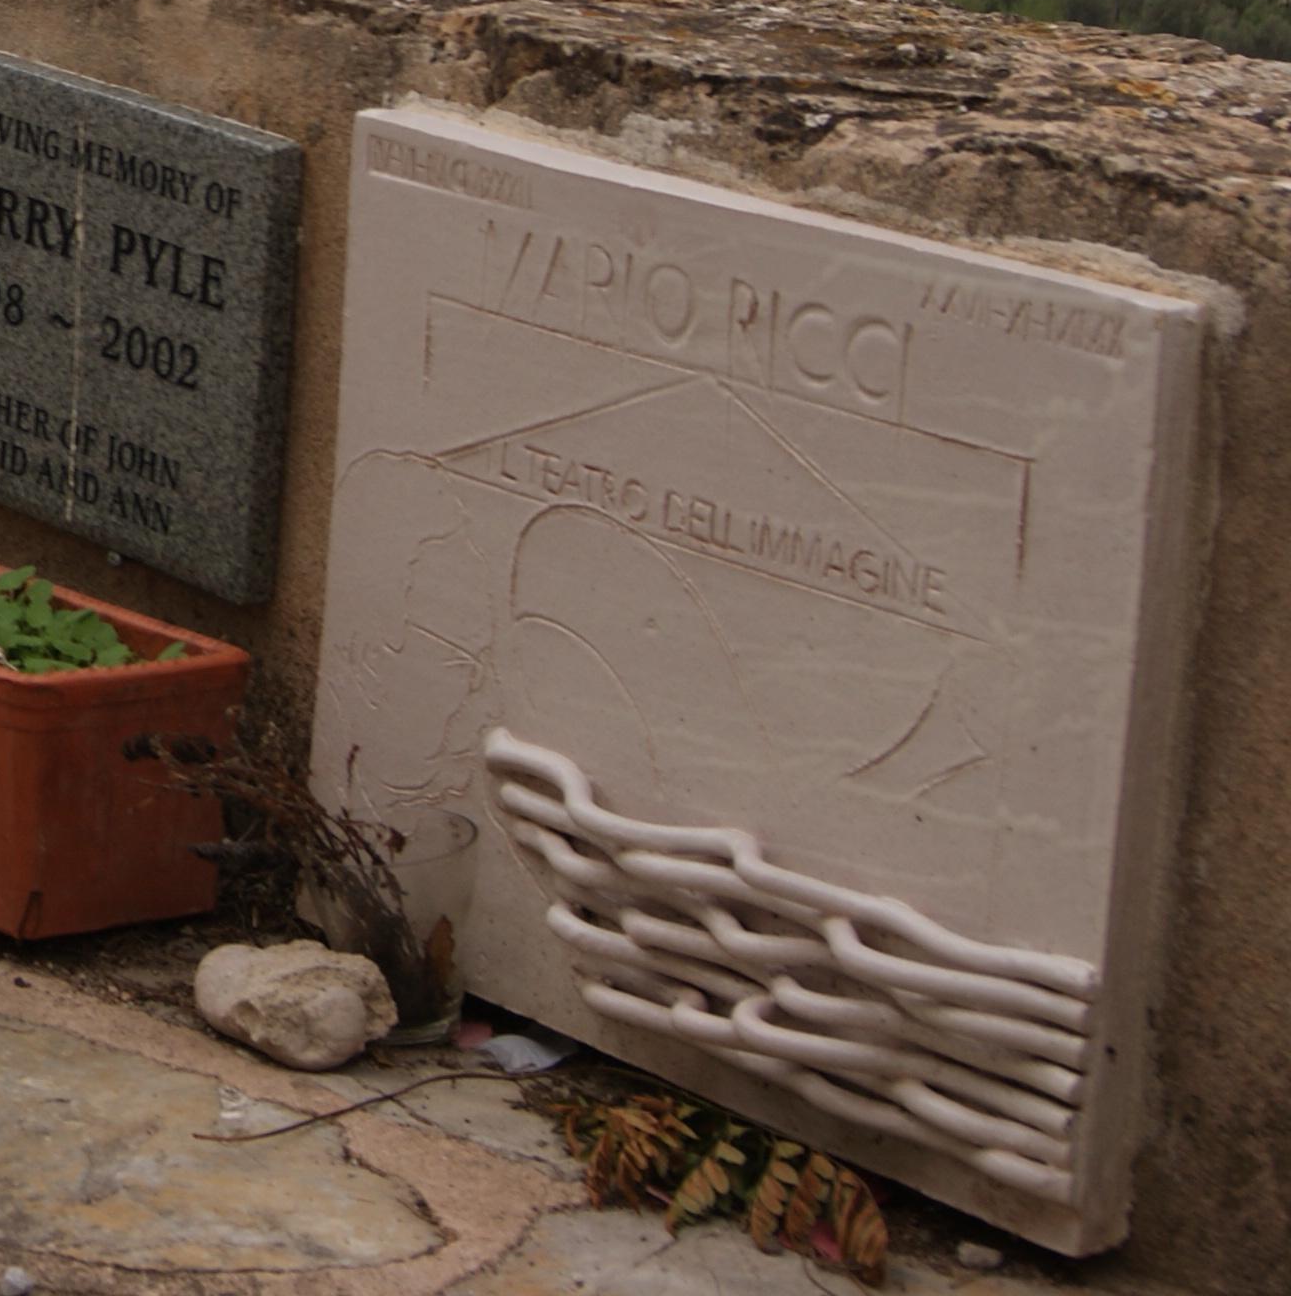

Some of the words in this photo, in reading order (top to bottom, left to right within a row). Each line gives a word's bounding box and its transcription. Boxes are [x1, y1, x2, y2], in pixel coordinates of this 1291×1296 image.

[69, 137, 199, 206] MEMORY
[204, 180, 243, 221] OF
[109, 223, 227, 312] PYLE
[100, 314, 200, 391] 2002
[479, 218, 694, 342] MARIO
[728, 276, 915, 426] RICCI
[36, 457, 100, 506] AND
[108, 486, 171, 535] ANN
[59, 420, 100, 458] OF
[105, 433, 182, 491] JOHN
[524, 442, 648, 523] TEATRO
